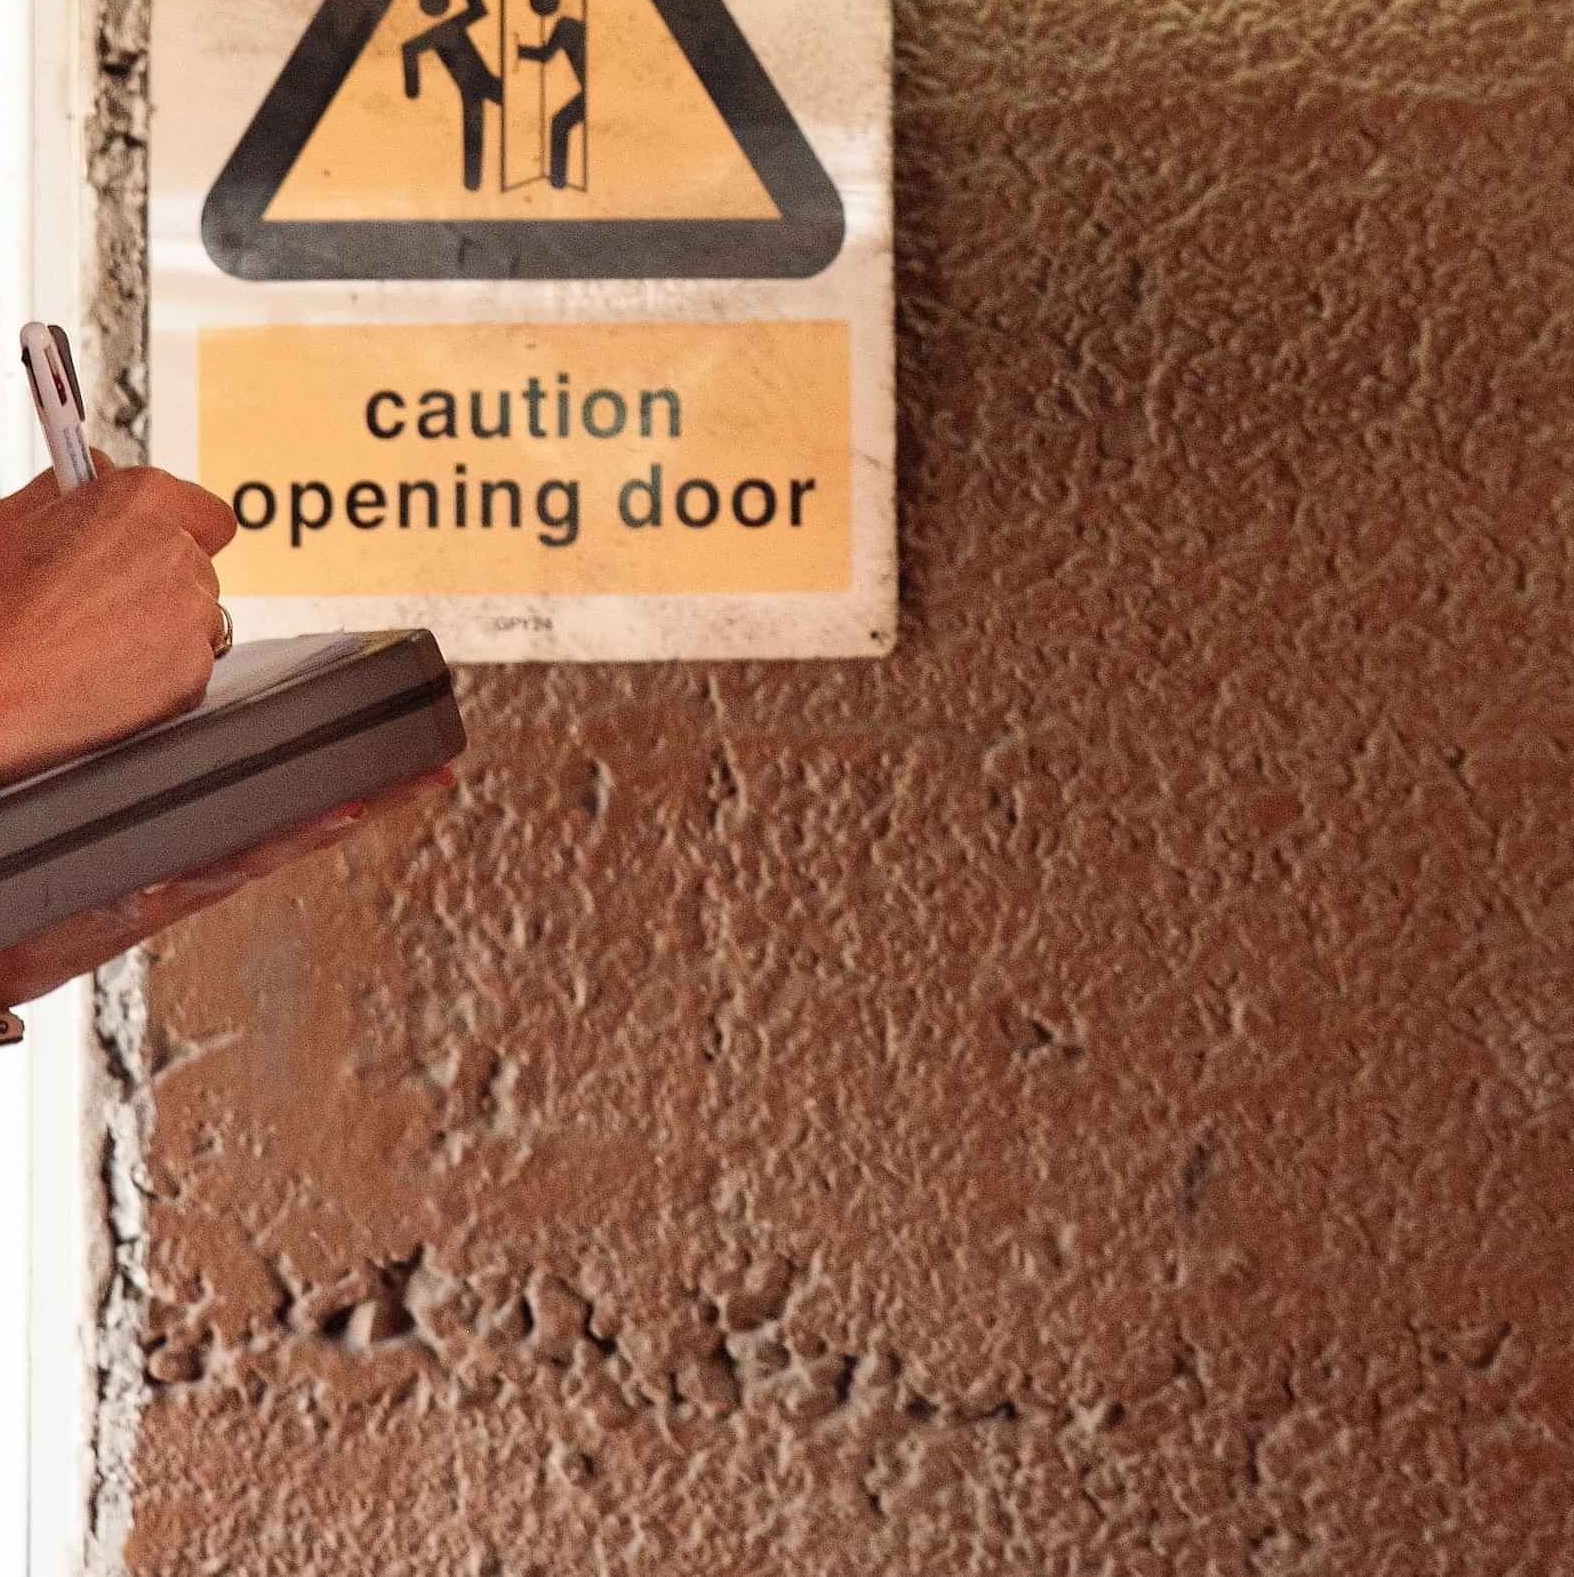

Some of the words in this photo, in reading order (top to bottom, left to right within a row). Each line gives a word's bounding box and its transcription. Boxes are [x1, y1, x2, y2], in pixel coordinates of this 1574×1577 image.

[365, 373, 682, 439] caution
[232, 463, 580, 547] opening
[618, 463, 816, 528] door
